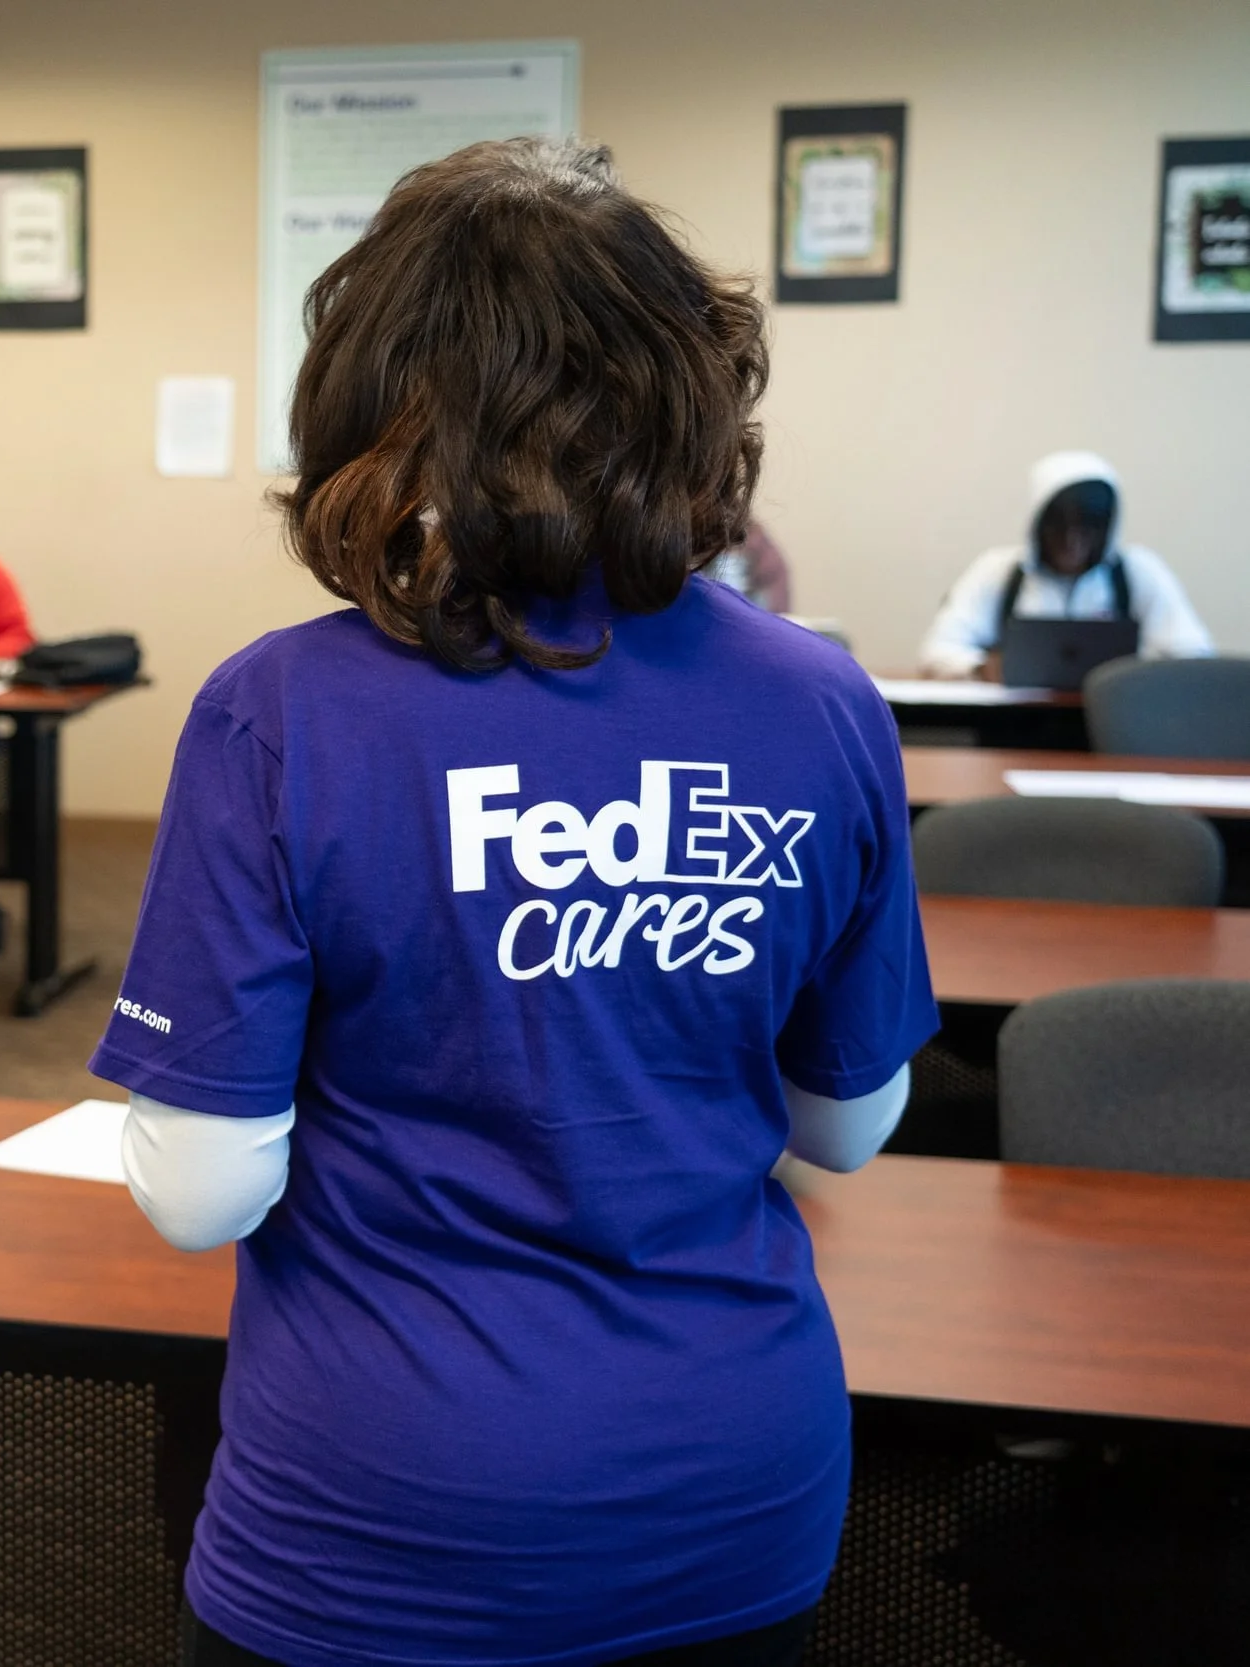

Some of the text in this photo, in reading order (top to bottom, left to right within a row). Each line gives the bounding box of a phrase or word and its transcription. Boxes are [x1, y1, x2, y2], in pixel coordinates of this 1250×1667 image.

[445, 759, 817, 893] FedEx
[497, 892, 765, 981] cares
[113, 996, 172, 1034] res.com
